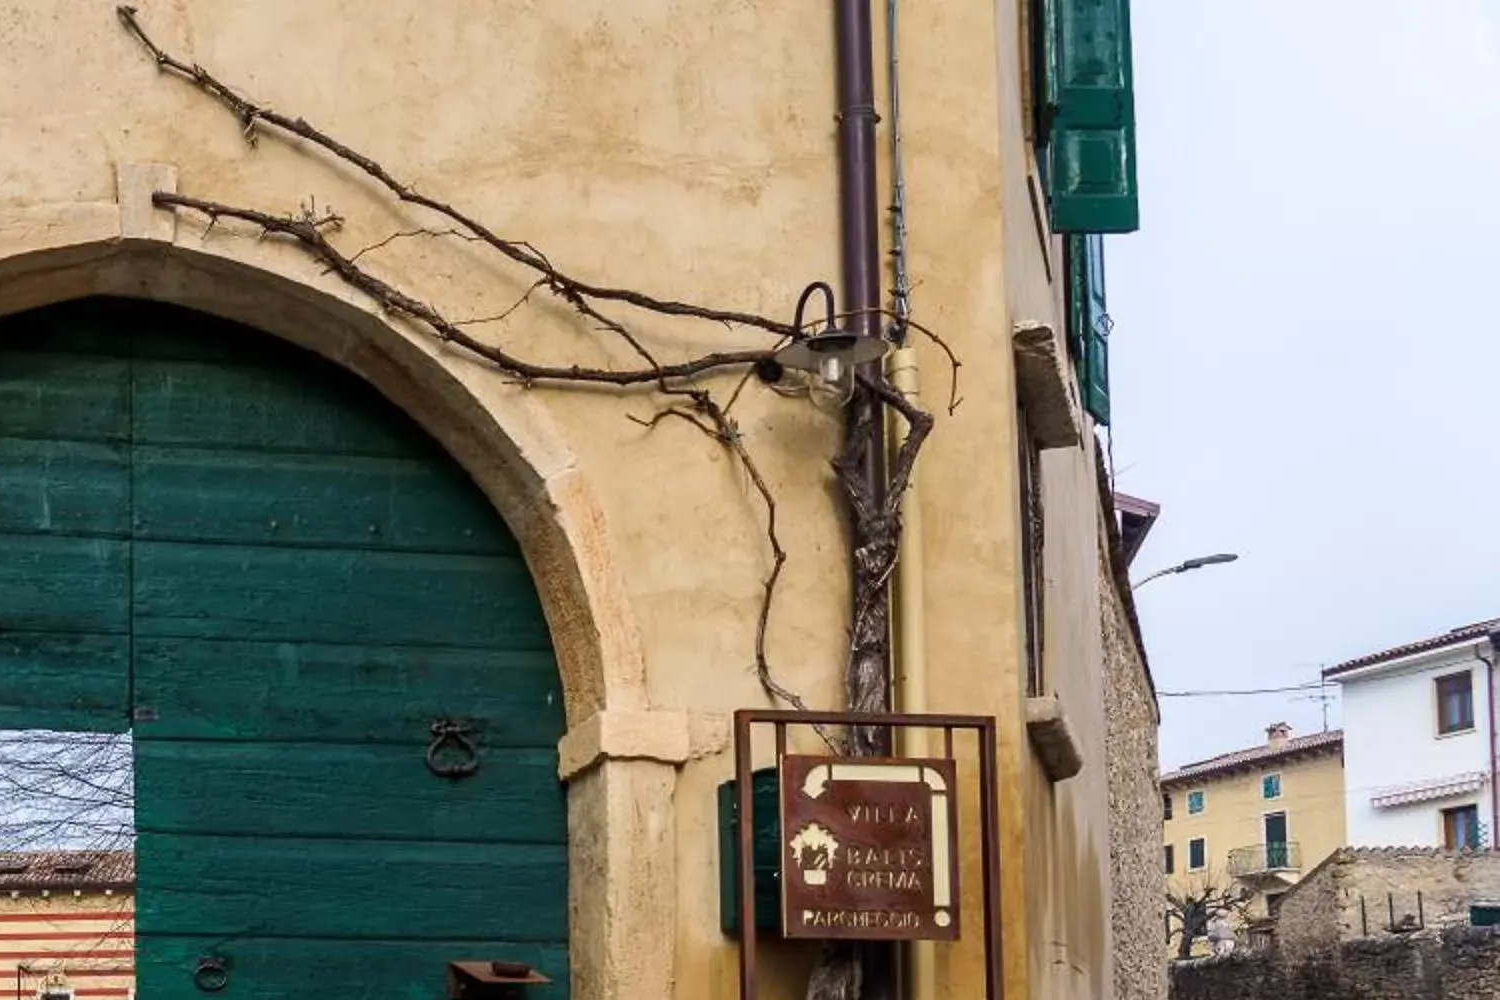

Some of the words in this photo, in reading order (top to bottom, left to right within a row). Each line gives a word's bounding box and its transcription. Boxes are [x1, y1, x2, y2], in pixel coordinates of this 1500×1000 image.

[849, 805, 918, 824] VILLA
[847, 871, 922, 889] CREMA
[802, 909, 921, 929] PARCHEGGIO
